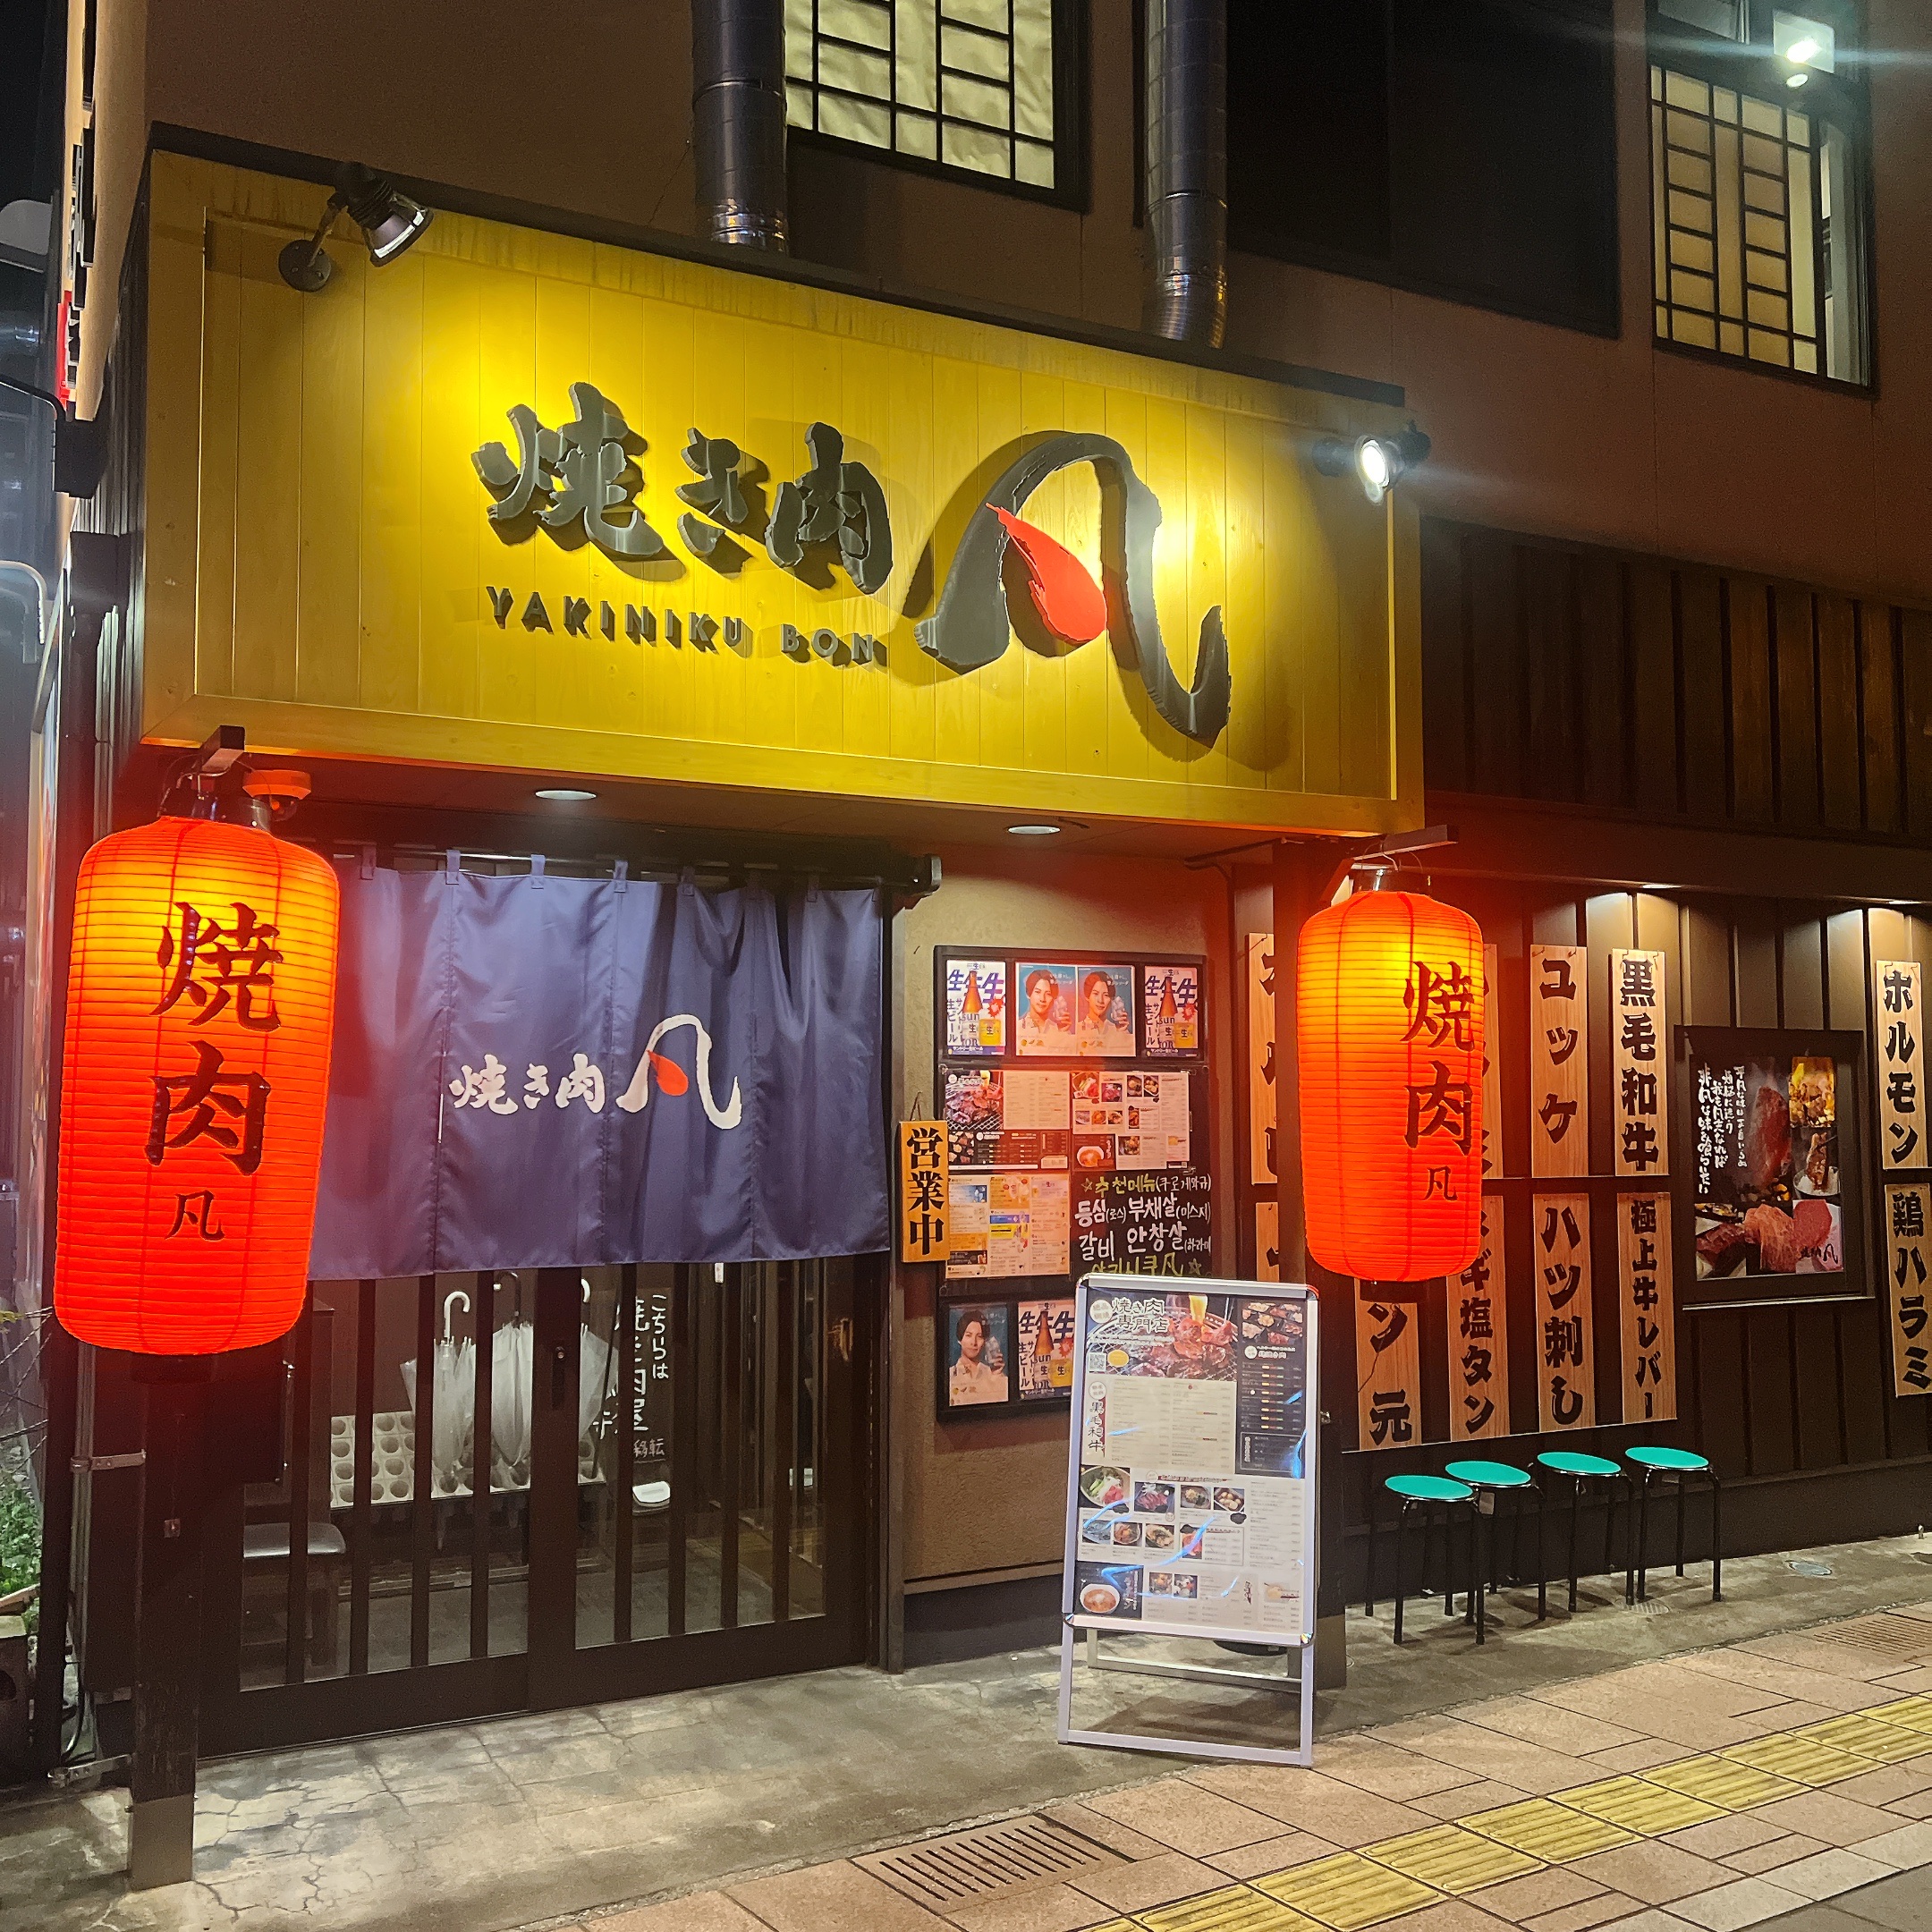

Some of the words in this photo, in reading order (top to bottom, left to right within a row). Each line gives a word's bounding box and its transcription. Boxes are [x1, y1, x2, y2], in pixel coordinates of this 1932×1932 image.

[486, 586, 744, 649] YAKINIKU
[781, 623, 877, 664] BON
[143, 902, 283, 1175] 焼肉
[448, 1053, 606, 1115] 焼き肉
[1400, 961, 1475, 1156] 焼肉
[1620, 959, 1659, 1171] 黒毛和牛
[1883, 970, 1919, 1164] ホルモン
[907, 1127, 945, 1256] 営業中
[1079, 1231, 1115, 1262] 갈비
[651, 1294, 669, 1379] こちらは
[1539, 1204, 1583, 1427] ハツ刺し
[1630, 1199, 1663, 1419] 極上牛レバー
[1893, 1191, 1931, 1391] 鶏ハラミ
